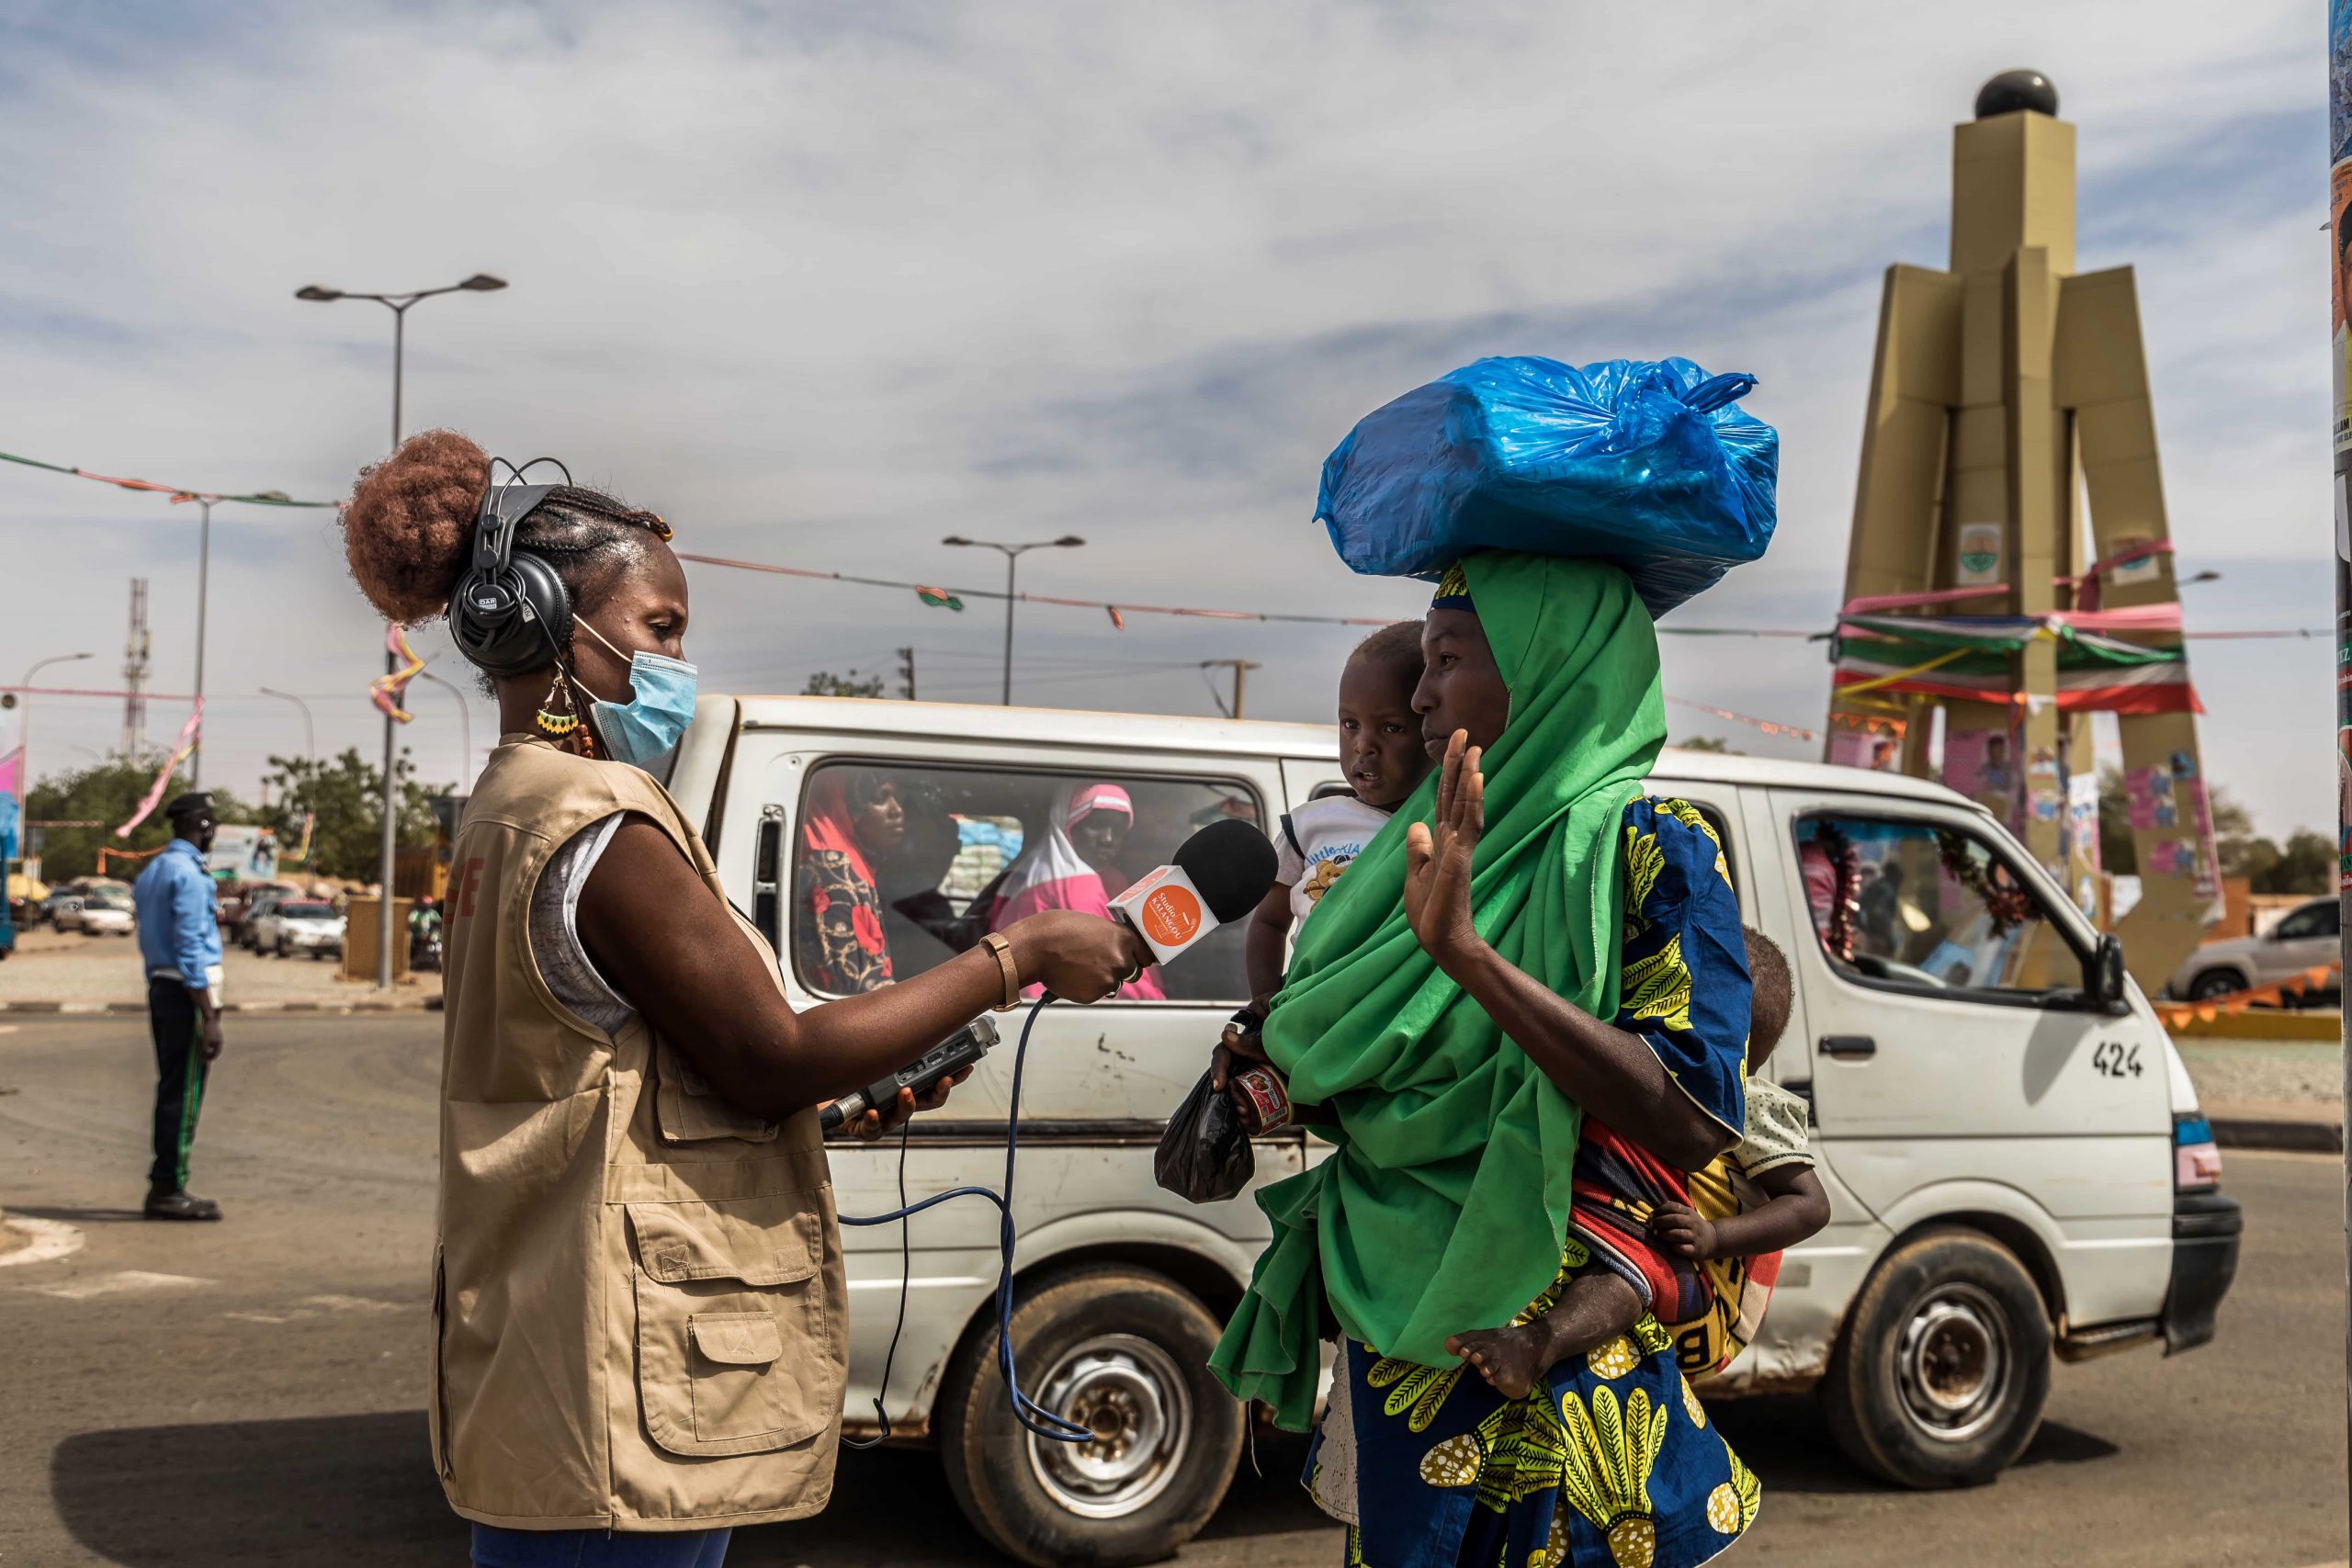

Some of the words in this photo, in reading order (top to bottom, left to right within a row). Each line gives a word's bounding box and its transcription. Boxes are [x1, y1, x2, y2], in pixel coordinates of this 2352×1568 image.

[1151, 897, 1182, 940] KALANGOU
[1158, 892, 1176, 919] Studio
[2094, 1041, 2143, 1077] 424
